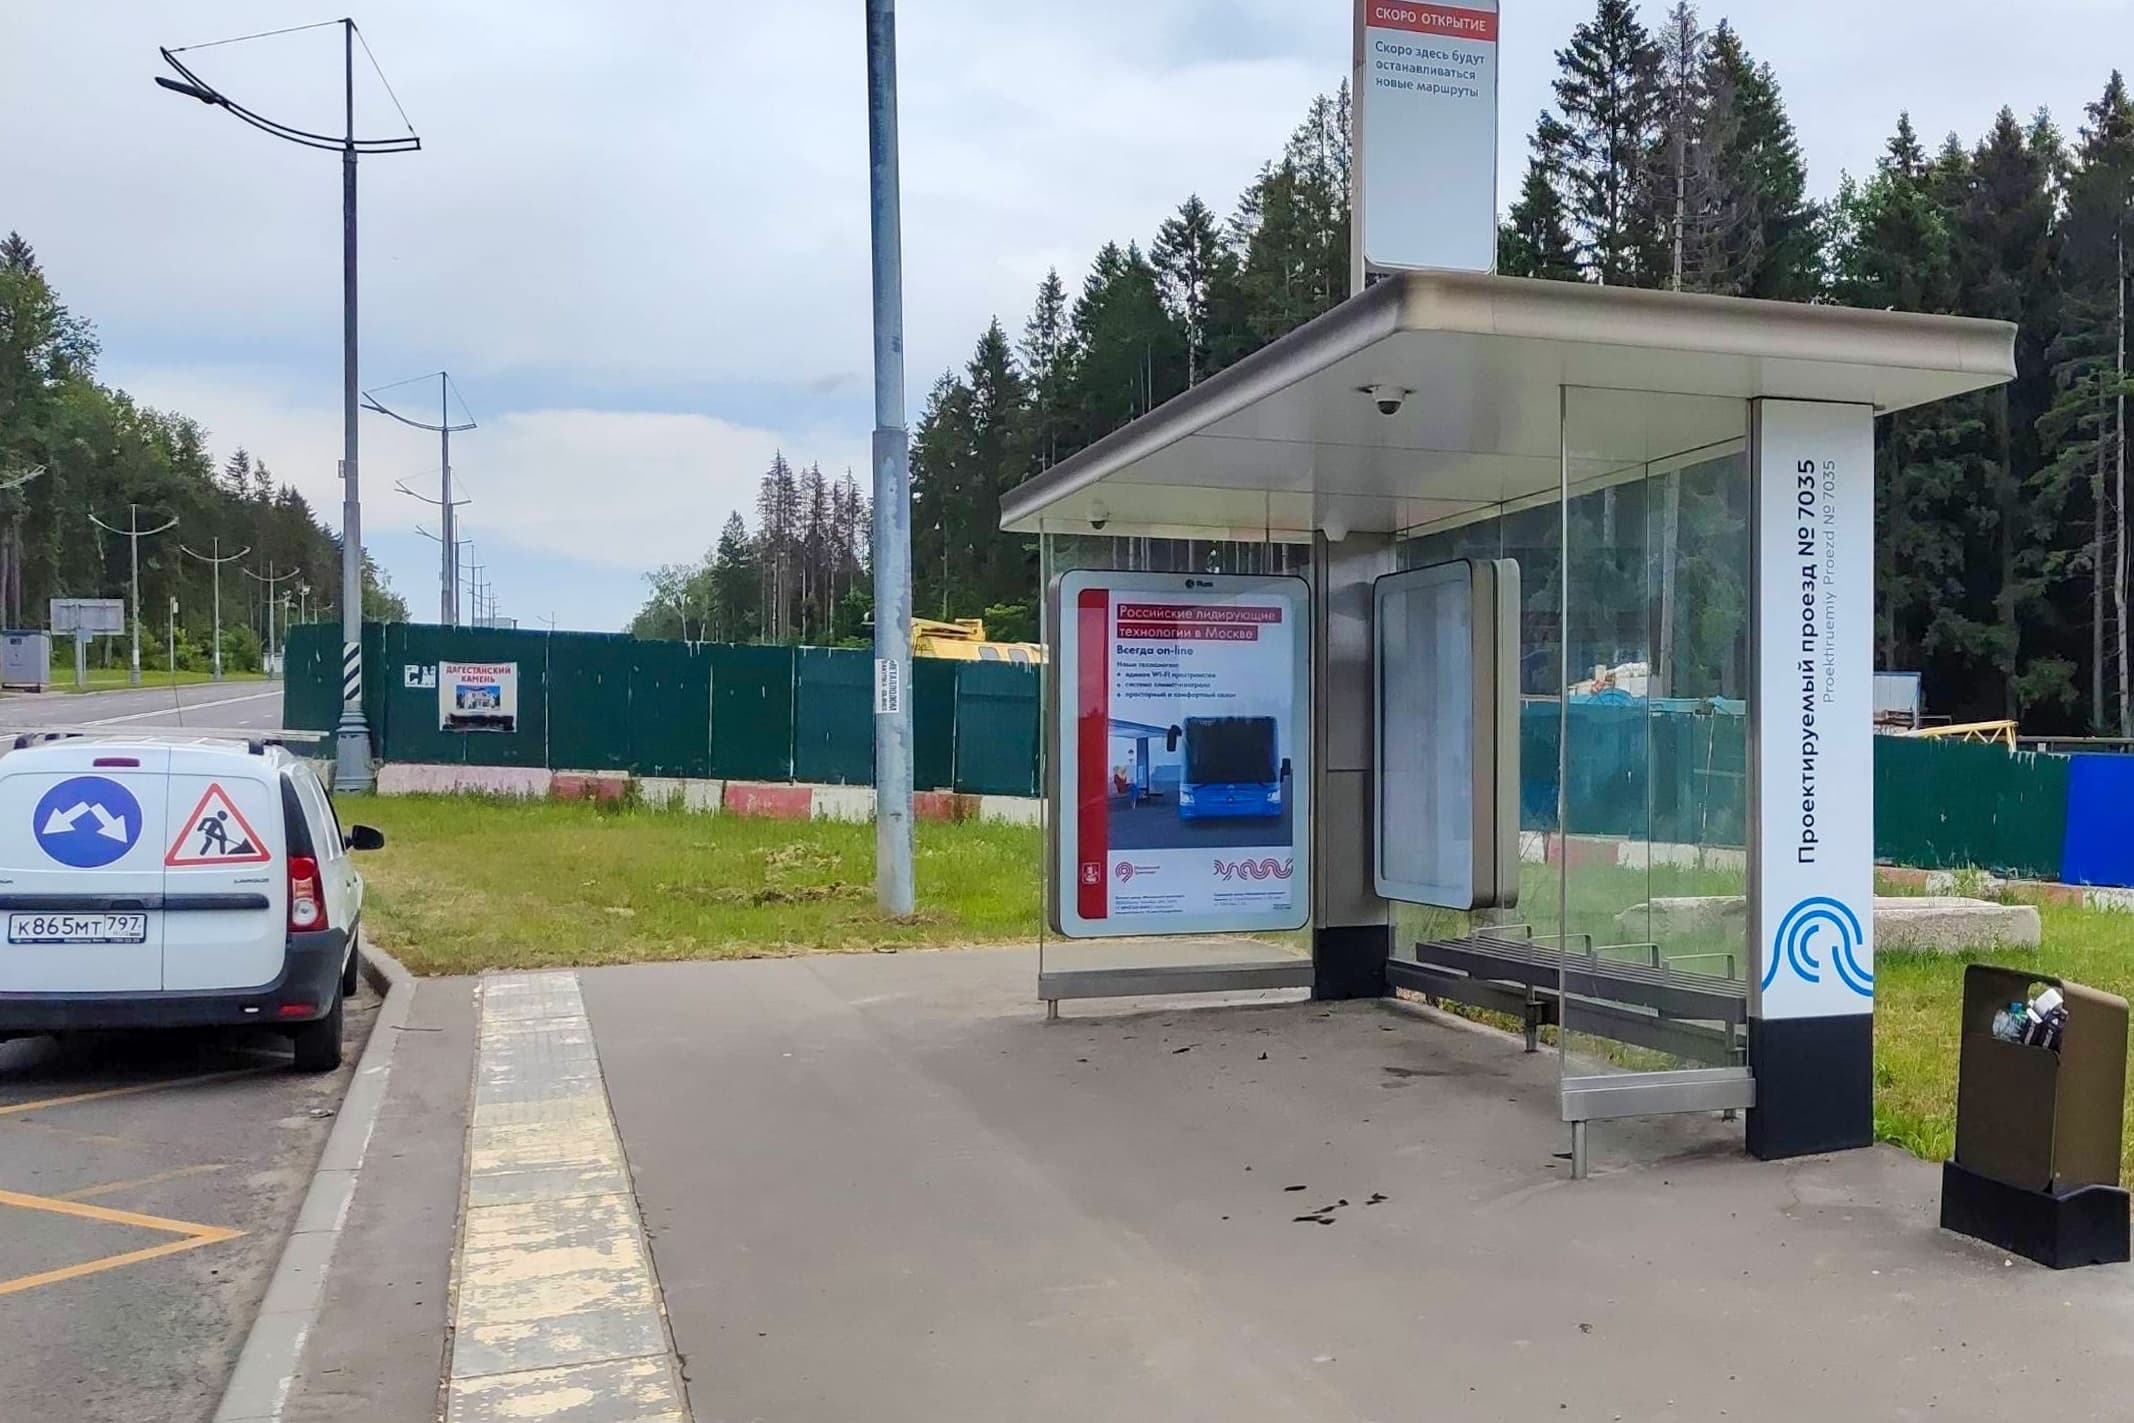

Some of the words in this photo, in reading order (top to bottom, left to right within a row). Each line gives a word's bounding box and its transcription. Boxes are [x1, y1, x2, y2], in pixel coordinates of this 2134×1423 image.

[1375, 7, 1416, 23] СКОРО
[1421, 12, 1487, 32] ОТКРЫТИЕ
[1375, 40, 1413, 56] Скоро
[1415, 47, 1449, 61] здесь
[1452, 50, 1485, 66] будут
[1375, 60, 1476, 80] останавливаться
[1376, 77, 1414, 90] новые
[1416, 83, 1479, 98] маршруты
[1797, 459, 1816, 520] 7035
[1823, 460, 1836, 501] 7035
[1798, 526, 1815, 556] №
[1823, 530, 1836, 585] Proezd
[1119, 605, 1193, 619] Российские
[1196, 609, 1276, 623] лидирующие
[1802, 563, 1819, 652] проезд
[1119, 626, 1191, 638] технологии
[1194, 629, 1202, 639] в
[1205, 626, 1253, 640] Москве
[1116, 644, 1154, 656] Всегда
[1156, 644, 1195, 656] on-line
[1822, 592, 1837, 703] Proektiruemiy
[446, 665, 511, 674] ДАГЕСТАНСКИЙ
[461, 674, 496, 683] КАМЕНЬ
[1798, 659, 1819, 864] Проектируемый
[18, 917, 103, 936] К865МТ
[107, 916, 139, 931] 797
